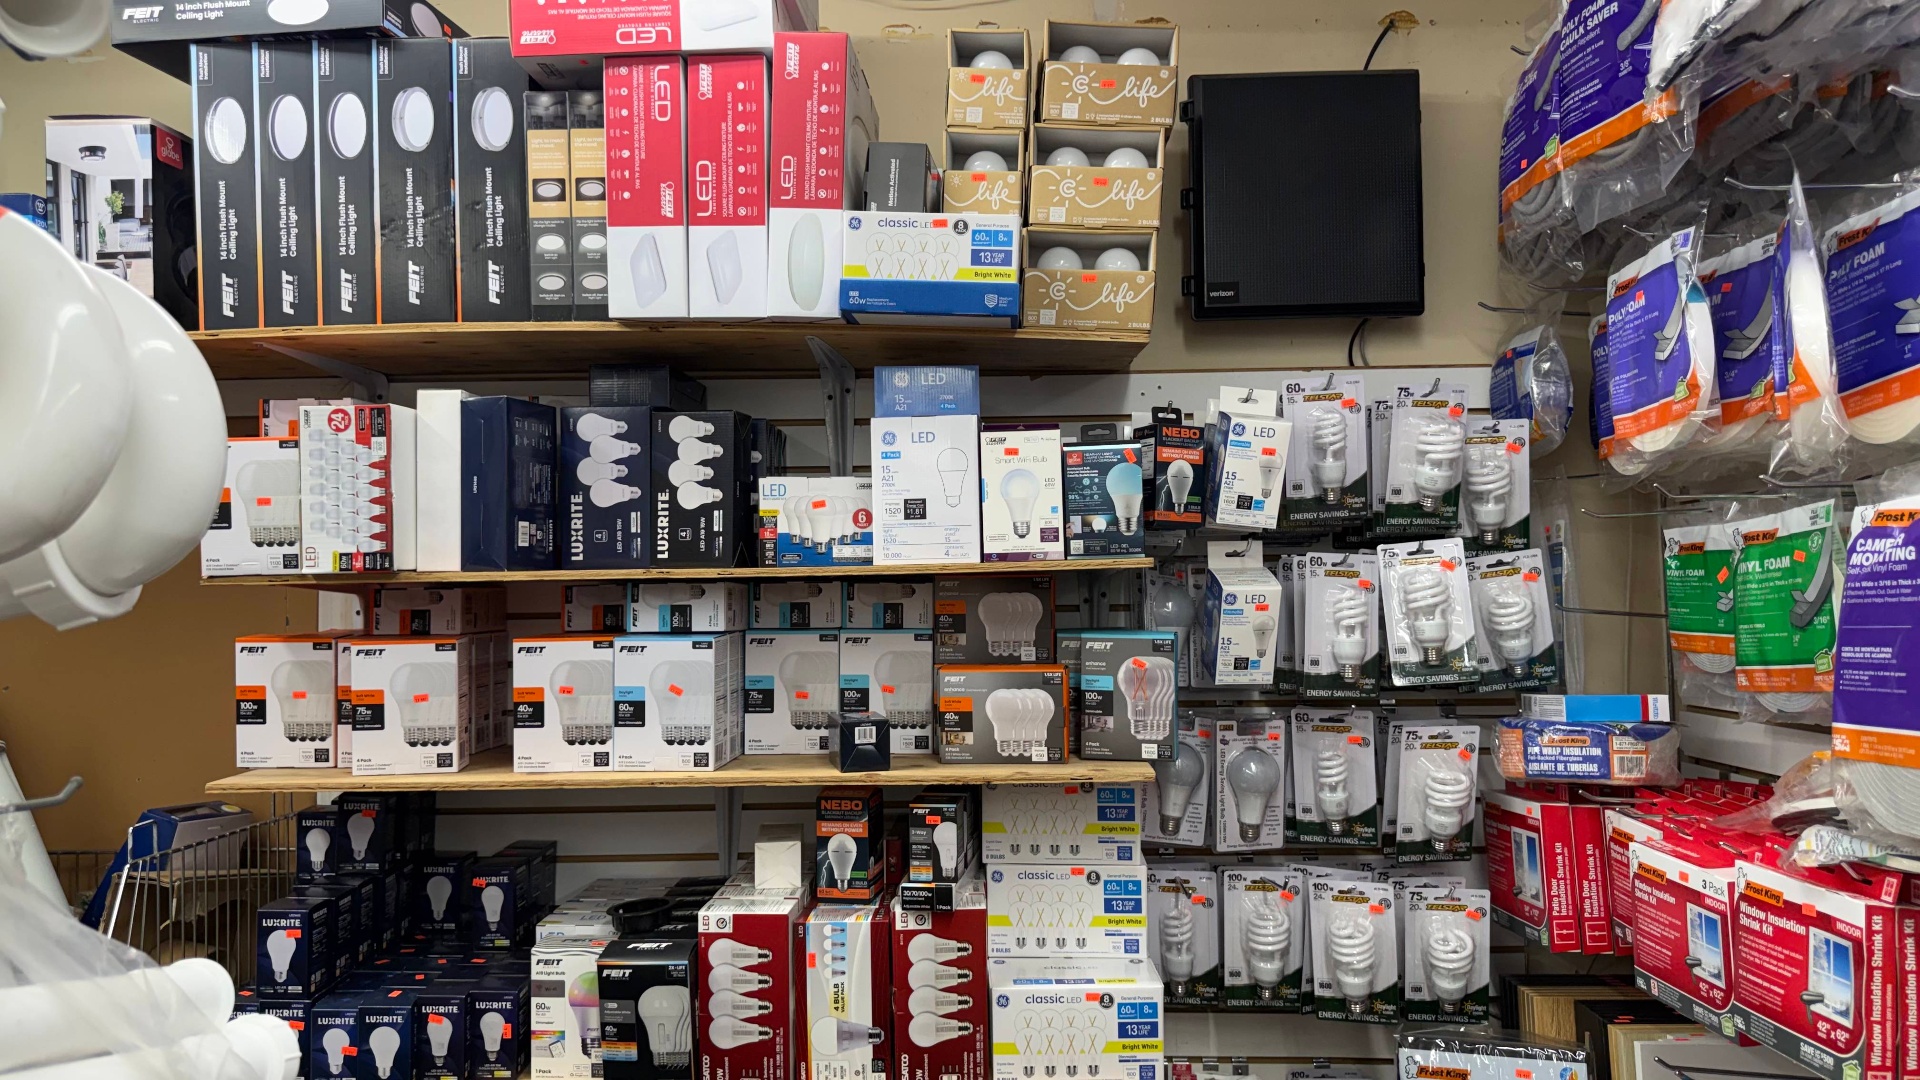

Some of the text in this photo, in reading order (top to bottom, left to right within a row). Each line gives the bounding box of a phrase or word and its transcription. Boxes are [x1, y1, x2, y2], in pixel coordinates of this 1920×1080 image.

[185, 2, 202, 10] inch
[203, 0, 224, 10] Flush
[122, 6, 165, 20] FEIT
[176, 10, 224, 20] Ceiling Light
[1560, 1, 1619, 52] CAULK SAVER
[615, 26, 672, 45] LED
[654, 65, 672, 122] LED
[982, 76, 1015, 107] life
[781, 155, 794, 200] LED
[695, 160, 713, 217] LED
[977, 180, 1010, 210] life
[878, 217, 918, 229] classic
[978, 252, 991, 264] 13
[1853, 242, 1886, 268] FOAM
[408, 260, 421, 305] FEIT
[488, 259, 501, 305] FEIT
[221, 272, 235, 318] FEIT
[281, 269, 295, 316] FEIT
[340, 268, 353, 314] FEIT
[920, 373, 946, 385] LED
[894, 394, 904, 403] 15
[1302, 393, 1344, 402] TELSTAR
[1411, 400, 1449, 408] TELSTAR
[332, 412, 345, 430] 24
[911, 432, 936, 444] LED
[1162, 426, 1200, 439] NEBO
[1254, 426, 1276, 438] LED
[1464, 436, 1506, 444] TELSTAR
[882, 466, 891, 474] 15
[1225, 471, 1237, 480] 15
[762, 484, 787, 497] LED
[858, 512, 867, 523] 6
[906, 508, 924, 516] $1.81
[1320, 510, 1349, 519] SAVINGS
[1876, 512, 1906, 522] Frost
[570, 494, 584, 561] LUXRITE
[656, 492, 669, 559] LUXRITE
[304, 546, 316, 568] LED
[1737, 555, 1791, 574] VINYL FOAM
[1324, 570, 1360, 578] TELSTAR
[1479, 567, 1522, 579] TELSTAR
[1245, 594, 1266, 604] LED
[1220, 637, 1232, 646] 15
[1478, 680, 1540, 692] ENERGY SAVINGS
[1312, 724, 1352, 734] TELSTAR
[1420, 742, 1460, 750] TELSTAR
[1542, 747, 1560, 756] WRAP
[1562, 747, 1602, 756] INSULATION
[1558, 763, 1566, 772] DE
[1566, 761, 1598, 772] TUBERÍAS
[820, 800, 863, 811] NEBO
[1104, 808, 1116, 818] 13
[1300, 834, 1358, 845] ENERGY SAVINGS
[1018, 870, 1054, 880] classic
[1638, 863, 1665, 882] Frost King
[1634, 878, 1676, 905] Window Insulation
[1702, 879, 1726, 898] 3 Pack
[1745, 881, 1782, 903] Frost King
[1111, 900, 1122, 910] 13
[1332, 895, 1370, 904] TELSTAR
[1704, 897, 1727, 912] INDOOR
[1426, 904, 1468, 912] TELSTAR
[262, 918, 302, 928] LUXRITE
[1739, 900, 1806, 936] Window Insulation
[1739, 915, 1773, 936] Shrink Kit
[1836, 920, 1862, 939] INDOOR
[536, 958, 563, 966] FEIT
[602, 968, 633, 978] FEIT
[1870, 915, 1882, 1066] Window Insulation Shrink Kit
[1904, 918, 1918, 1070] Window Insulation Shrink Kit
[1025, 994, 1065, 1004] classic
[1256, 1000, 1284, 1008] SAVINGS
[422, 1006, 460, 1014] LUXRITE
[476, 1002, 514, 1010] LUXRITE
[266, 1010, 305, 1018] LUXRITE
[366, 1016, 404, 1024] LUXRITE
[1318, 1011, 1379, 1022] ENERGY SAVINGS
[1408, 1013, 1469, 1023] ENERGY SAVINGS
[318, 1017, 356, 1026] LUXRITE
[1126, 1024, 1138, 1036] 13
